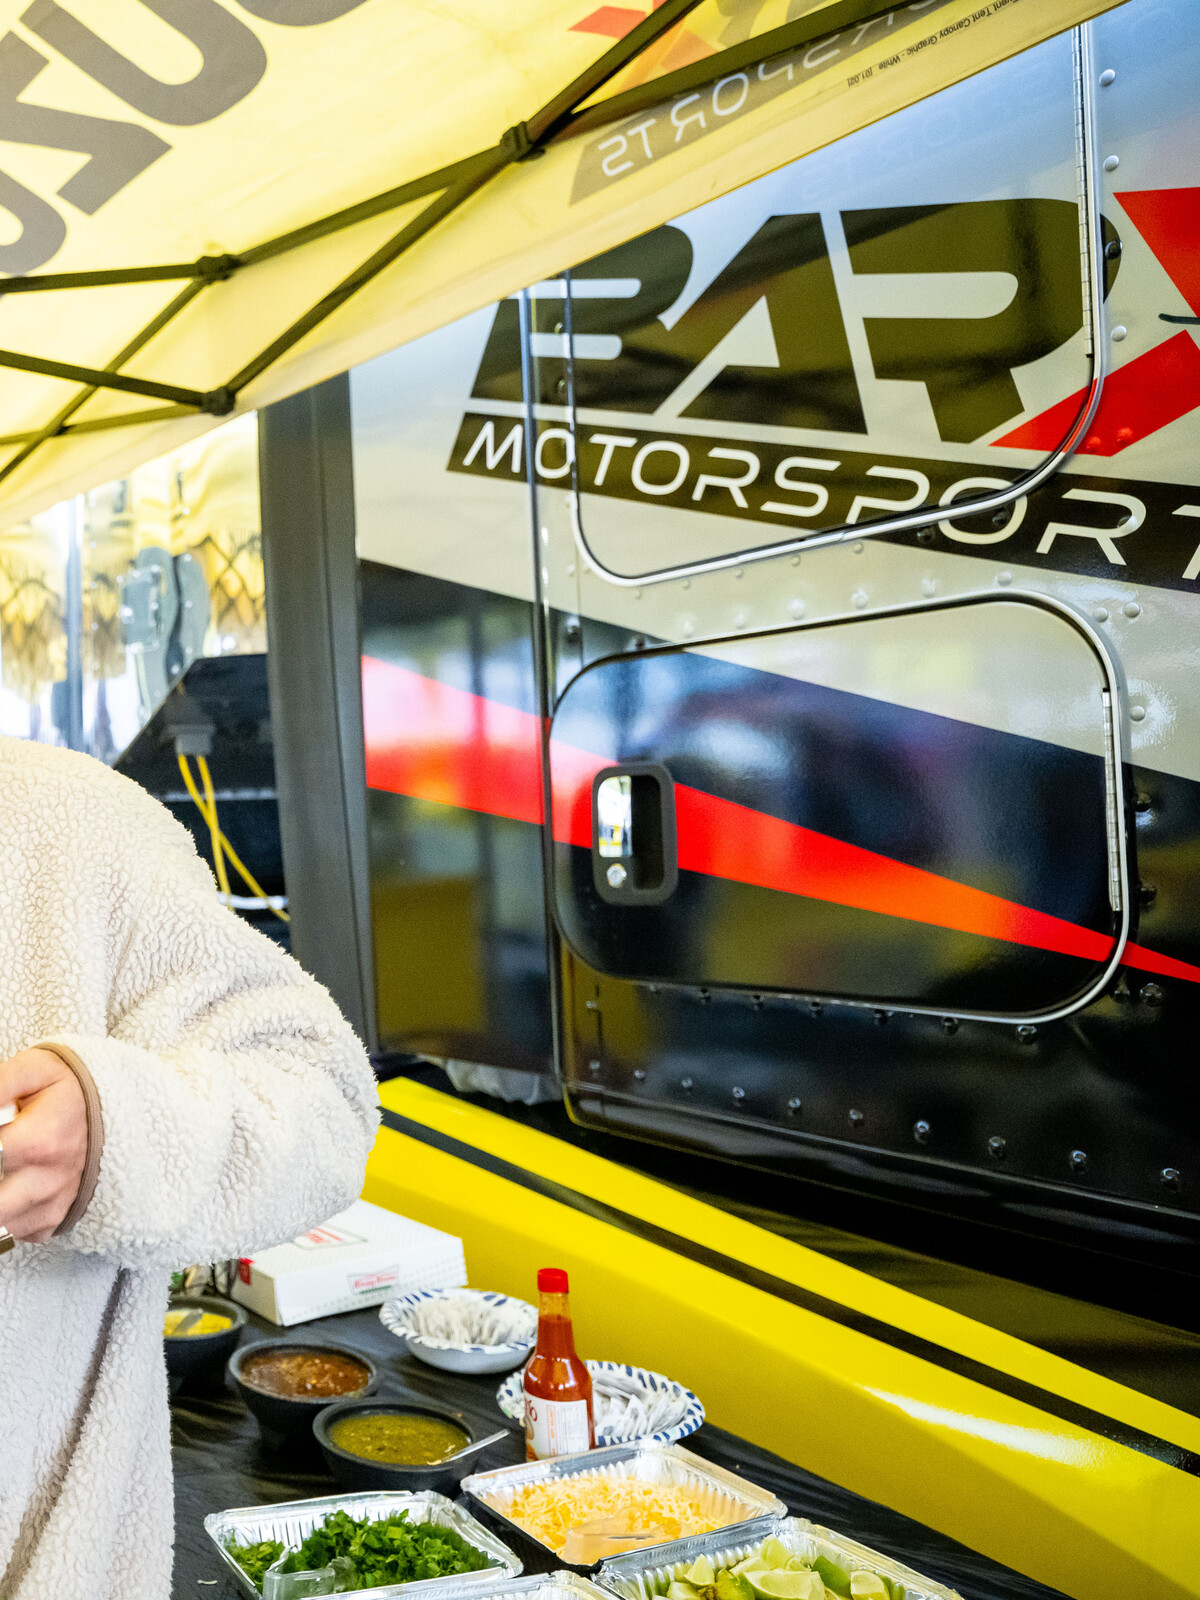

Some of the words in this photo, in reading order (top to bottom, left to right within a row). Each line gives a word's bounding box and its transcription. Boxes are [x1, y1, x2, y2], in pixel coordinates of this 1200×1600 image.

[972, 7, 992, 22] Tent
[939, 18, 971, 38] Canopy
[906, 35, 938, 56] Graphic
[878, 55, 901, 70] White
